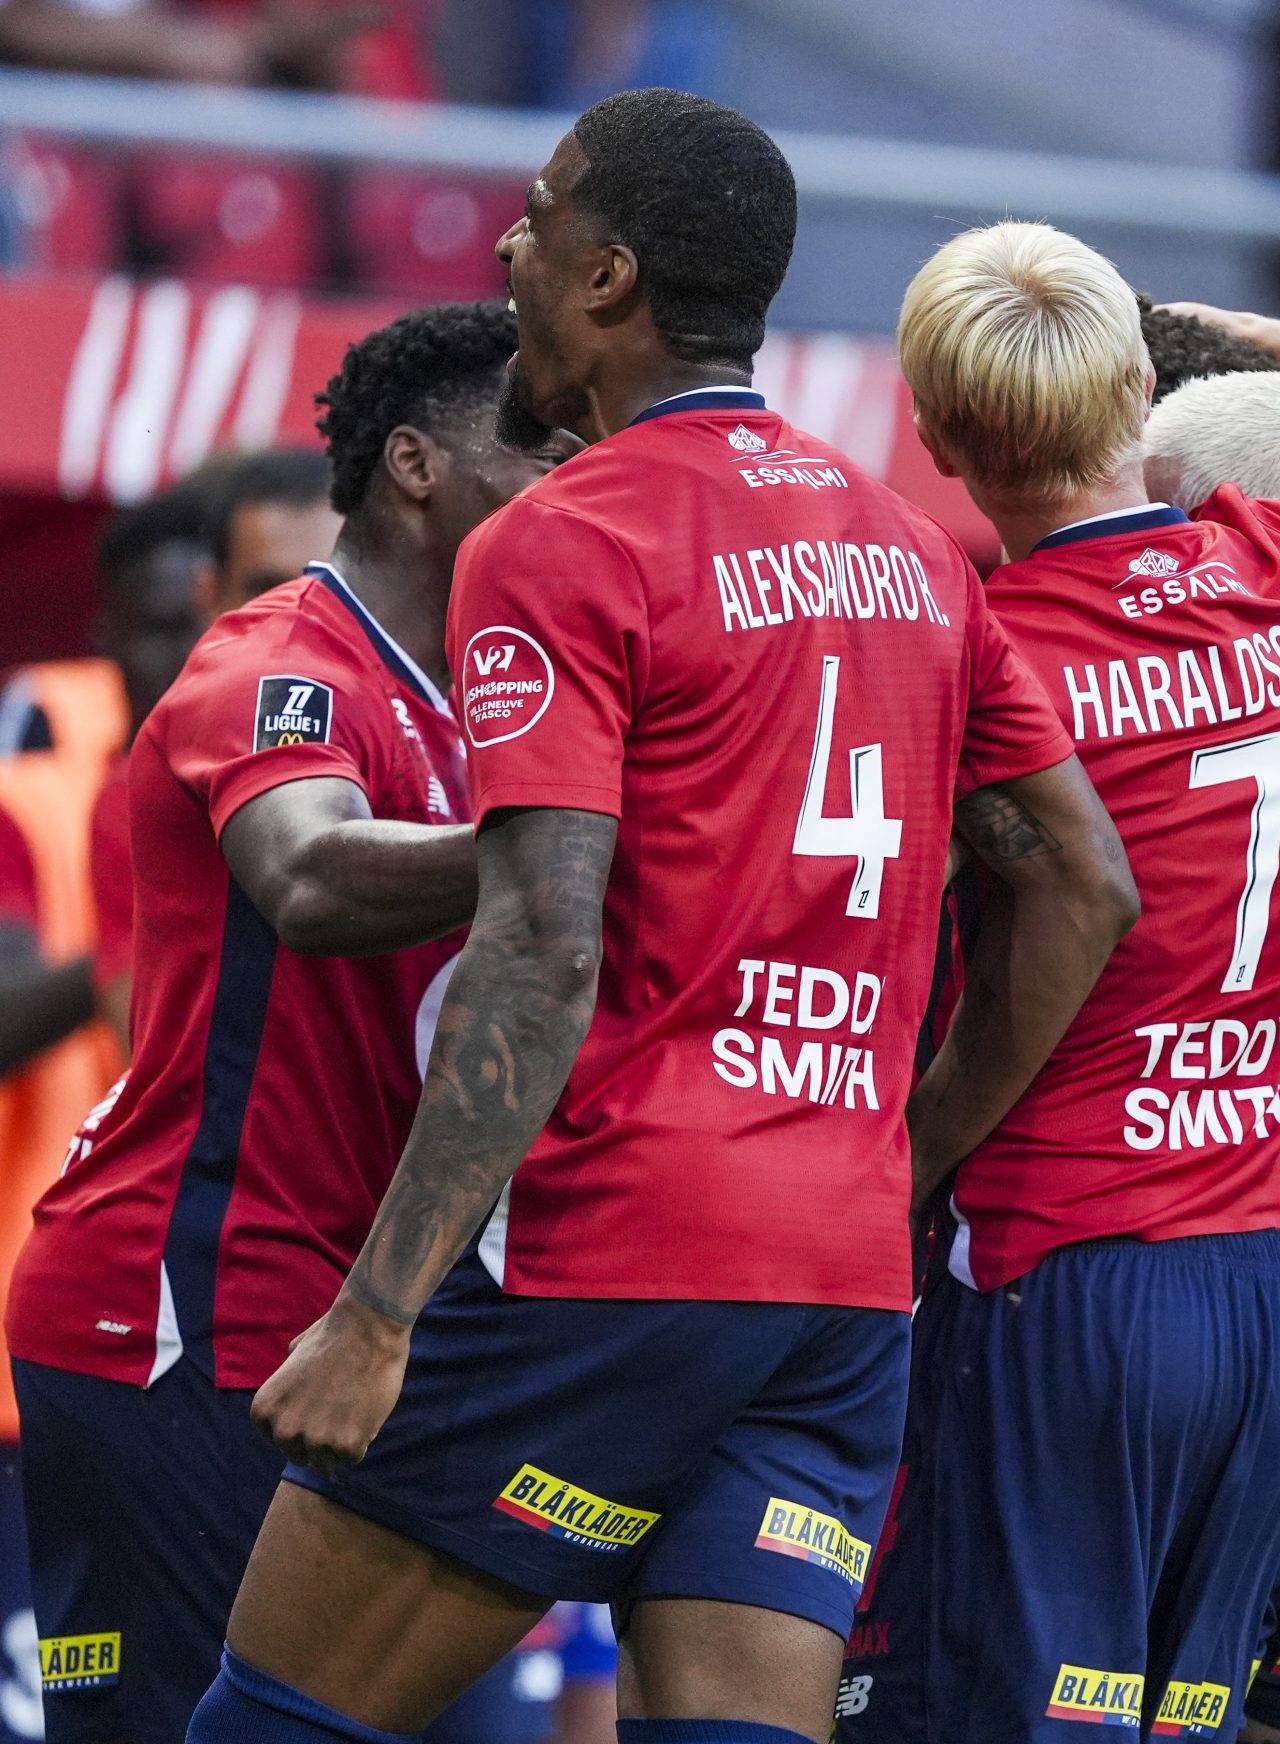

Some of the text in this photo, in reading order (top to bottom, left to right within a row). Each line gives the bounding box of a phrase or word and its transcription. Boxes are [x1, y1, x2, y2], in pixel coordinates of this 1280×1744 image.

[738, 467, 849, 490] ESSALMI
[1117, 572, 1255, 618] ESSALMI
[264, 714, 321, 734] LIGUE 1
[792, 655, 903, 919] 4
[733, 959, 886, 1036] TEDD
[509, 1474, 649, 1541] BLÅKLÄDER
[563, 1530, 619, 1551] WORKWEAR
[767, 1507, 866, 1577] BLÅKLÄDER
[1057, 1674, 1142, 1713] BLÅKL
